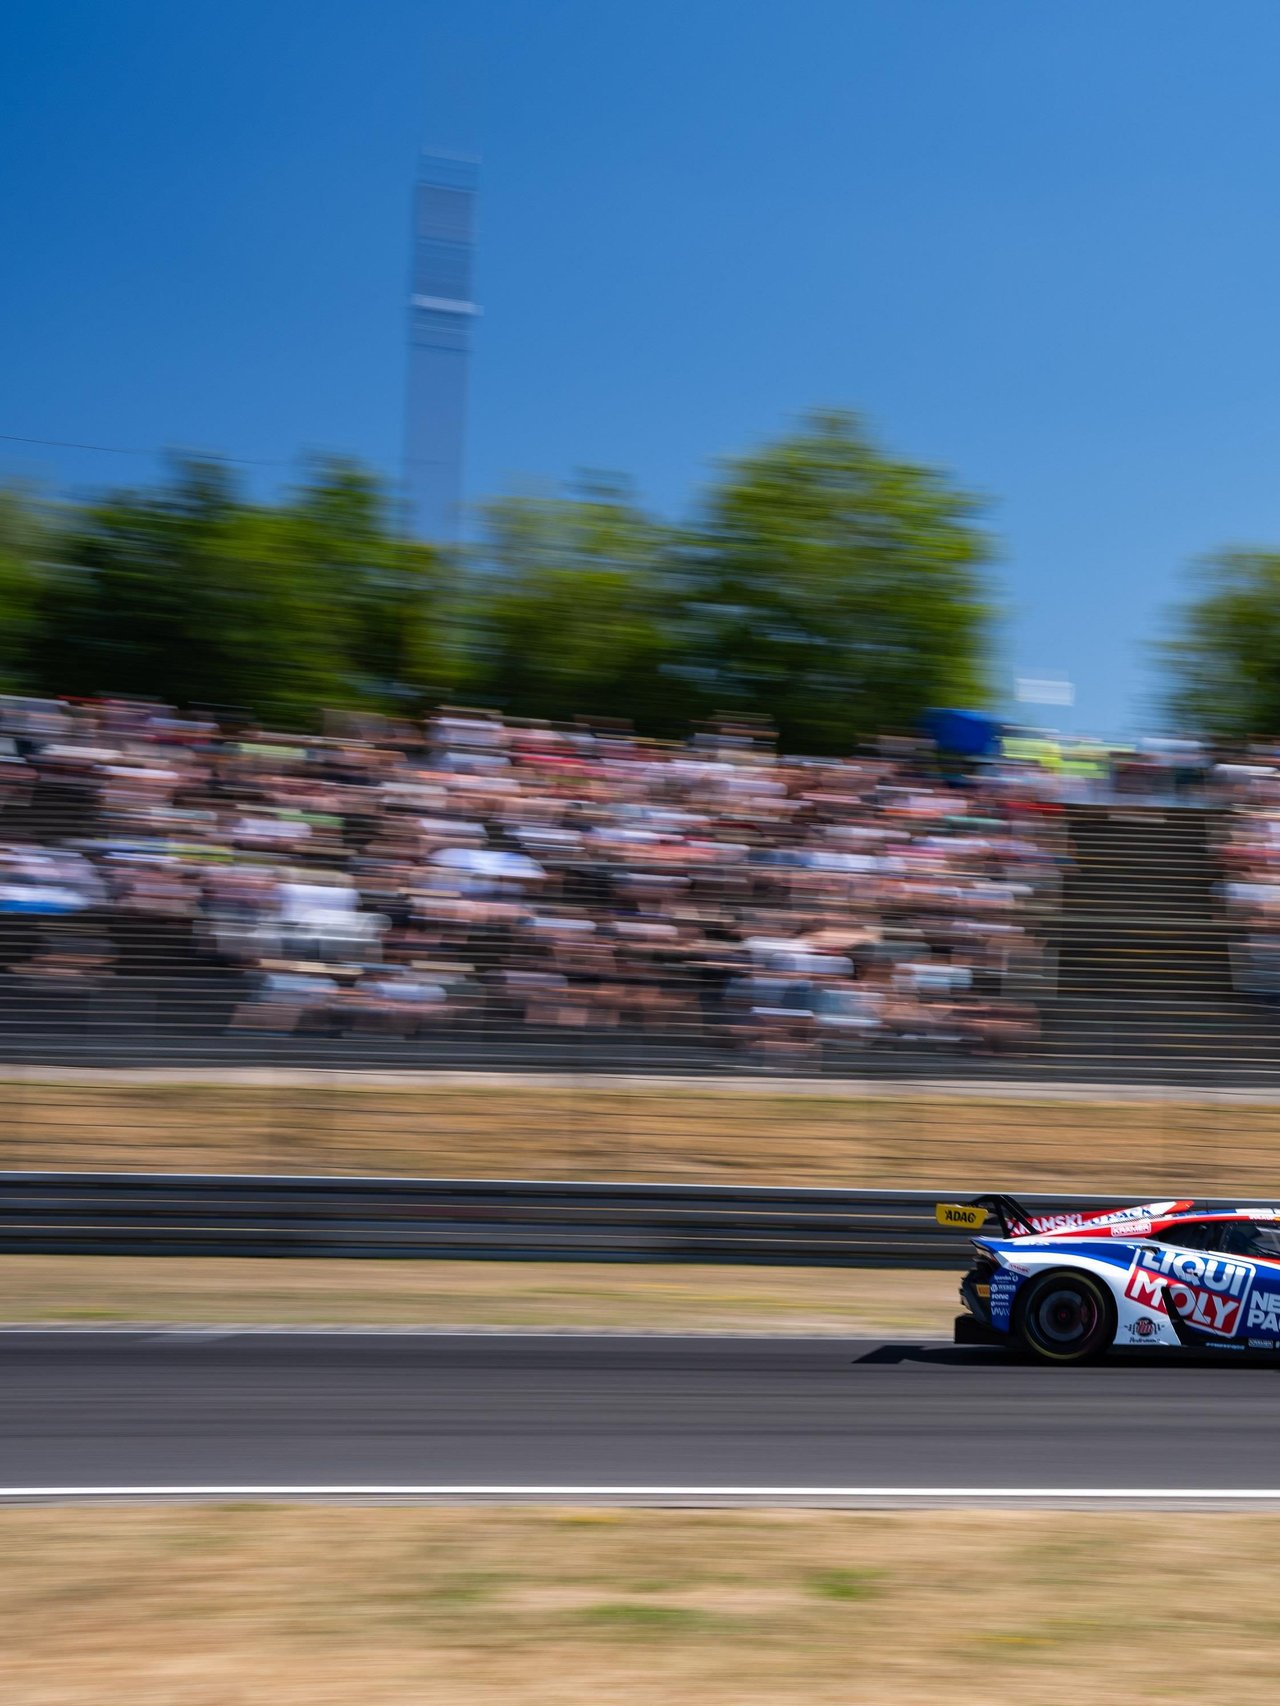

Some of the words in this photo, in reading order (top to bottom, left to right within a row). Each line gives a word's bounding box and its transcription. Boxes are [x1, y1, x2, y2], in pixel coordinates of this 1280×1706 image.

[945, 1210, 976, 1223] ADAC
[1142, 1250, 1246, 1296] LIQUI
[1130, 1269, 1239, 1329] MOLY
